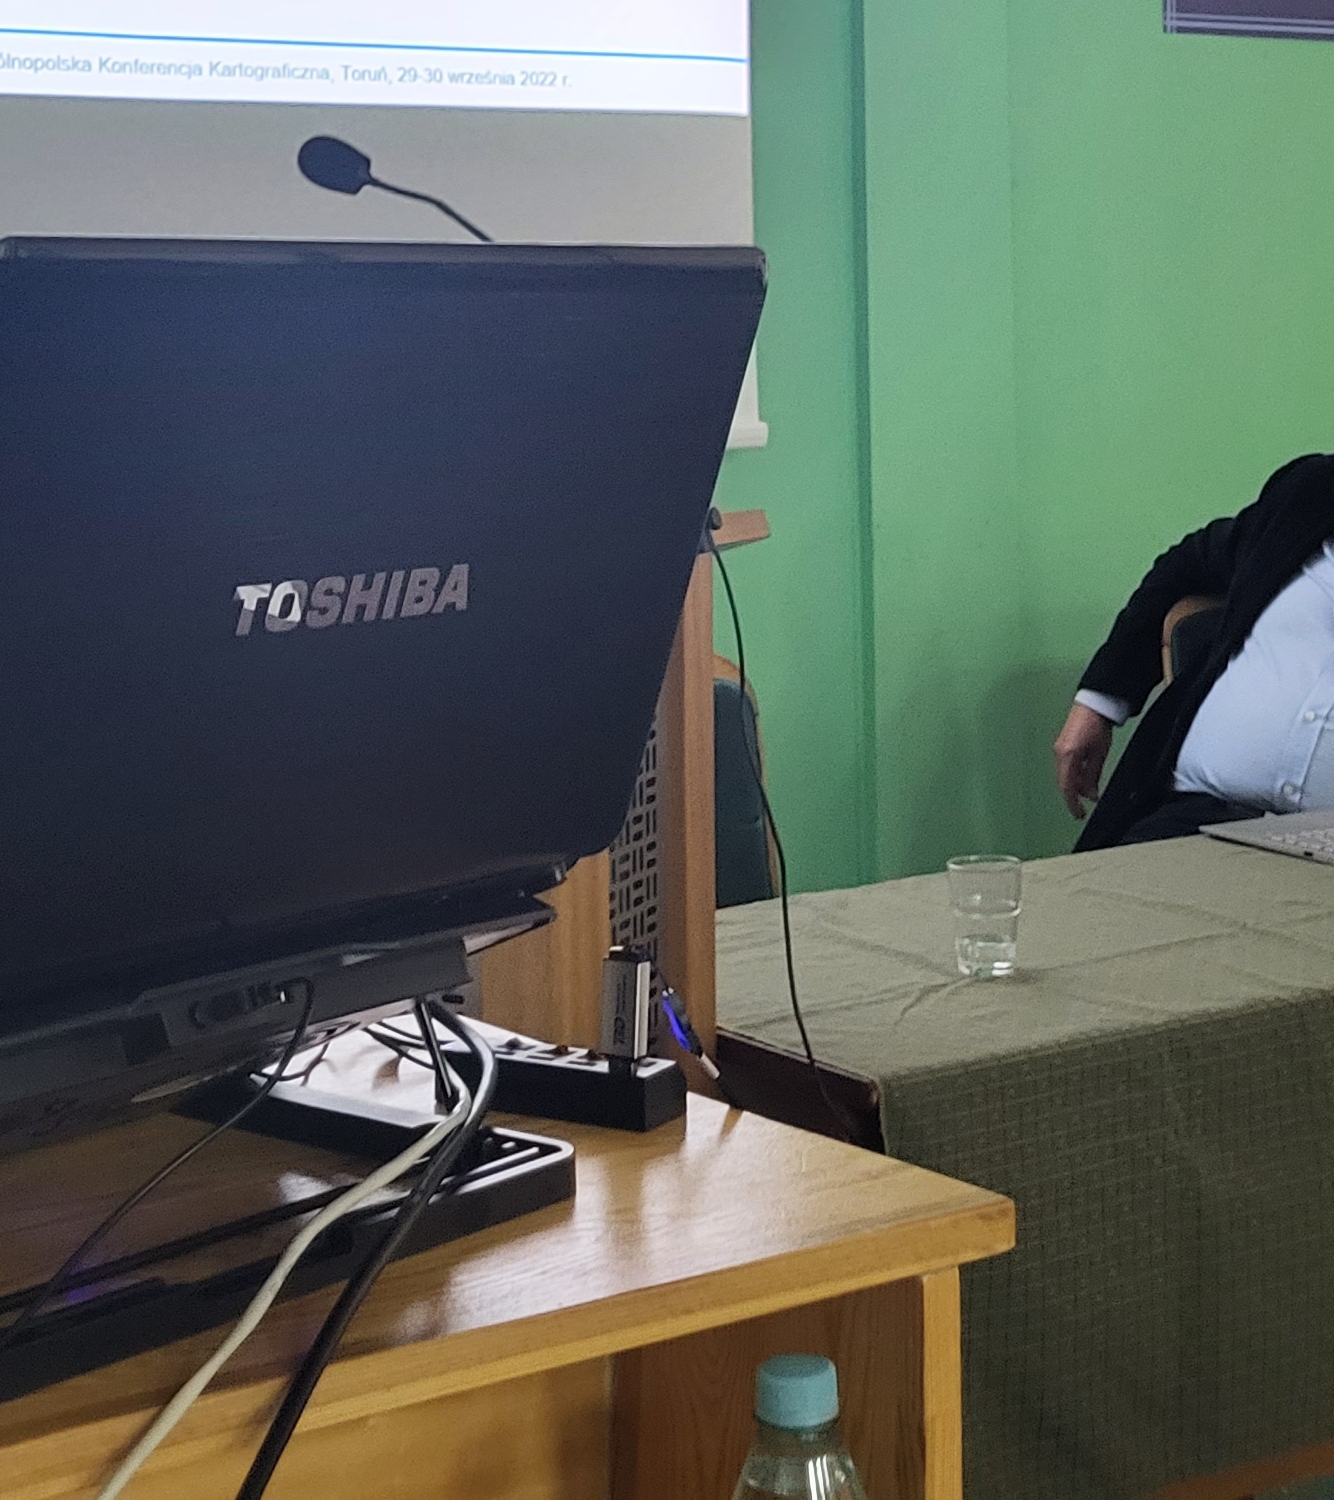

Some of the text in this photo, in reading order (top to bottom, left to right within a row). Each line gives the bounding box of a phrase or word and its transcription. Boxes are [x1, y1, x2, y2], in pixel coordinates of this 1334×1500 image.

[97, 56, 204, 80] Konferencja
[208, 60, 335, 84] Kartograficzna,
[340, 64, 393, 86] Toruń,
[396, 66, 444, 84] 29-30
[446, 69, 517, 87] września
[519, 69, 558, 88] 2022
[234, 563, 470, 636] TOSHIBA
